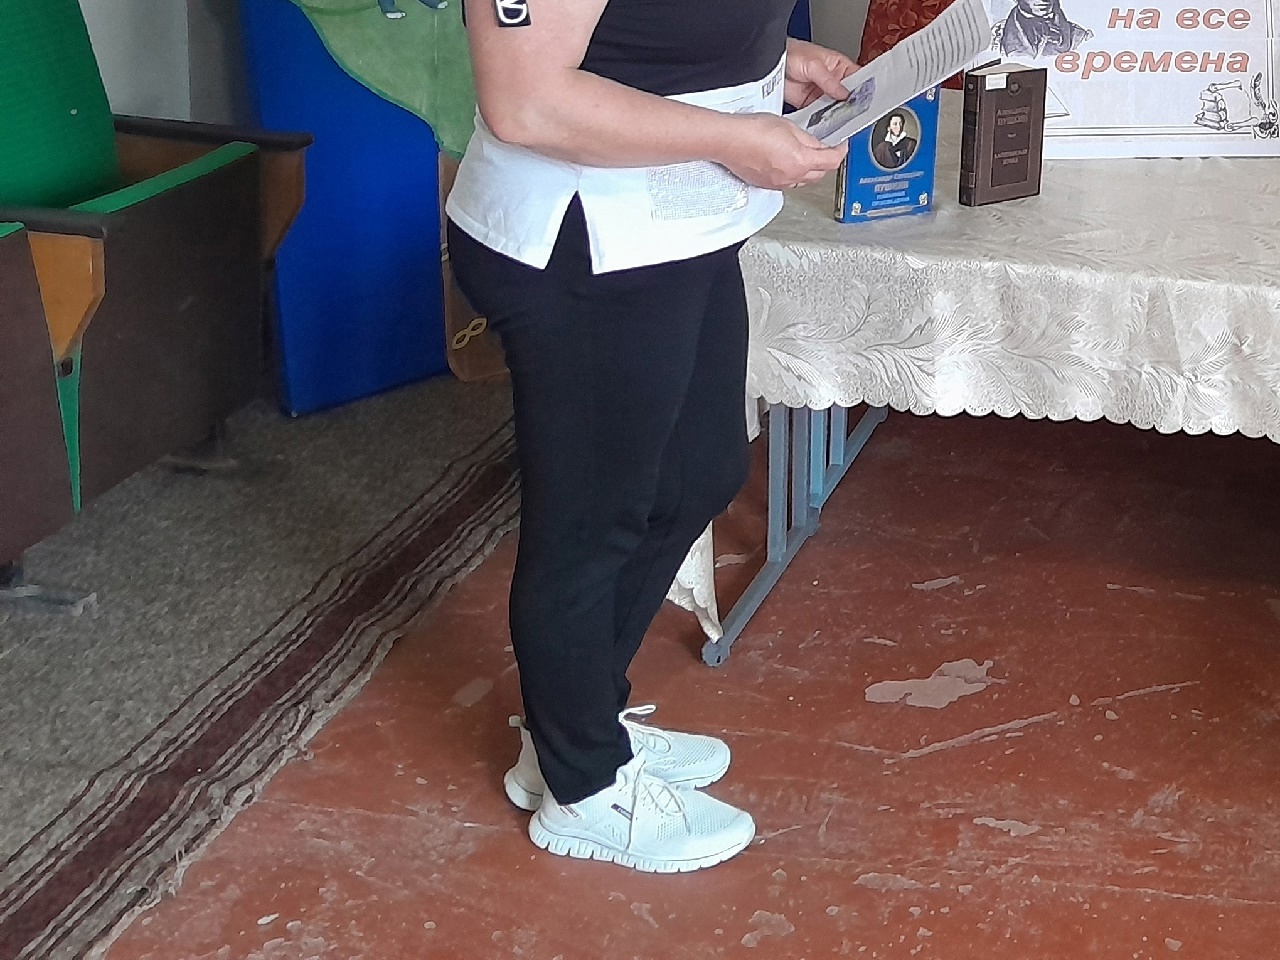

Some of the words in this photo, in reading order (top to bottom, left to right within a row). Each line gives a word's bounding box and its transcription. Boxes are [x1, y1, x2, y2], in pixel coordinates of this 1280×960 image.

[1107, 8, 1161, 30] на
[1176, 8, 1251, 30] все
[1055, 50, 1250, 79] времена
